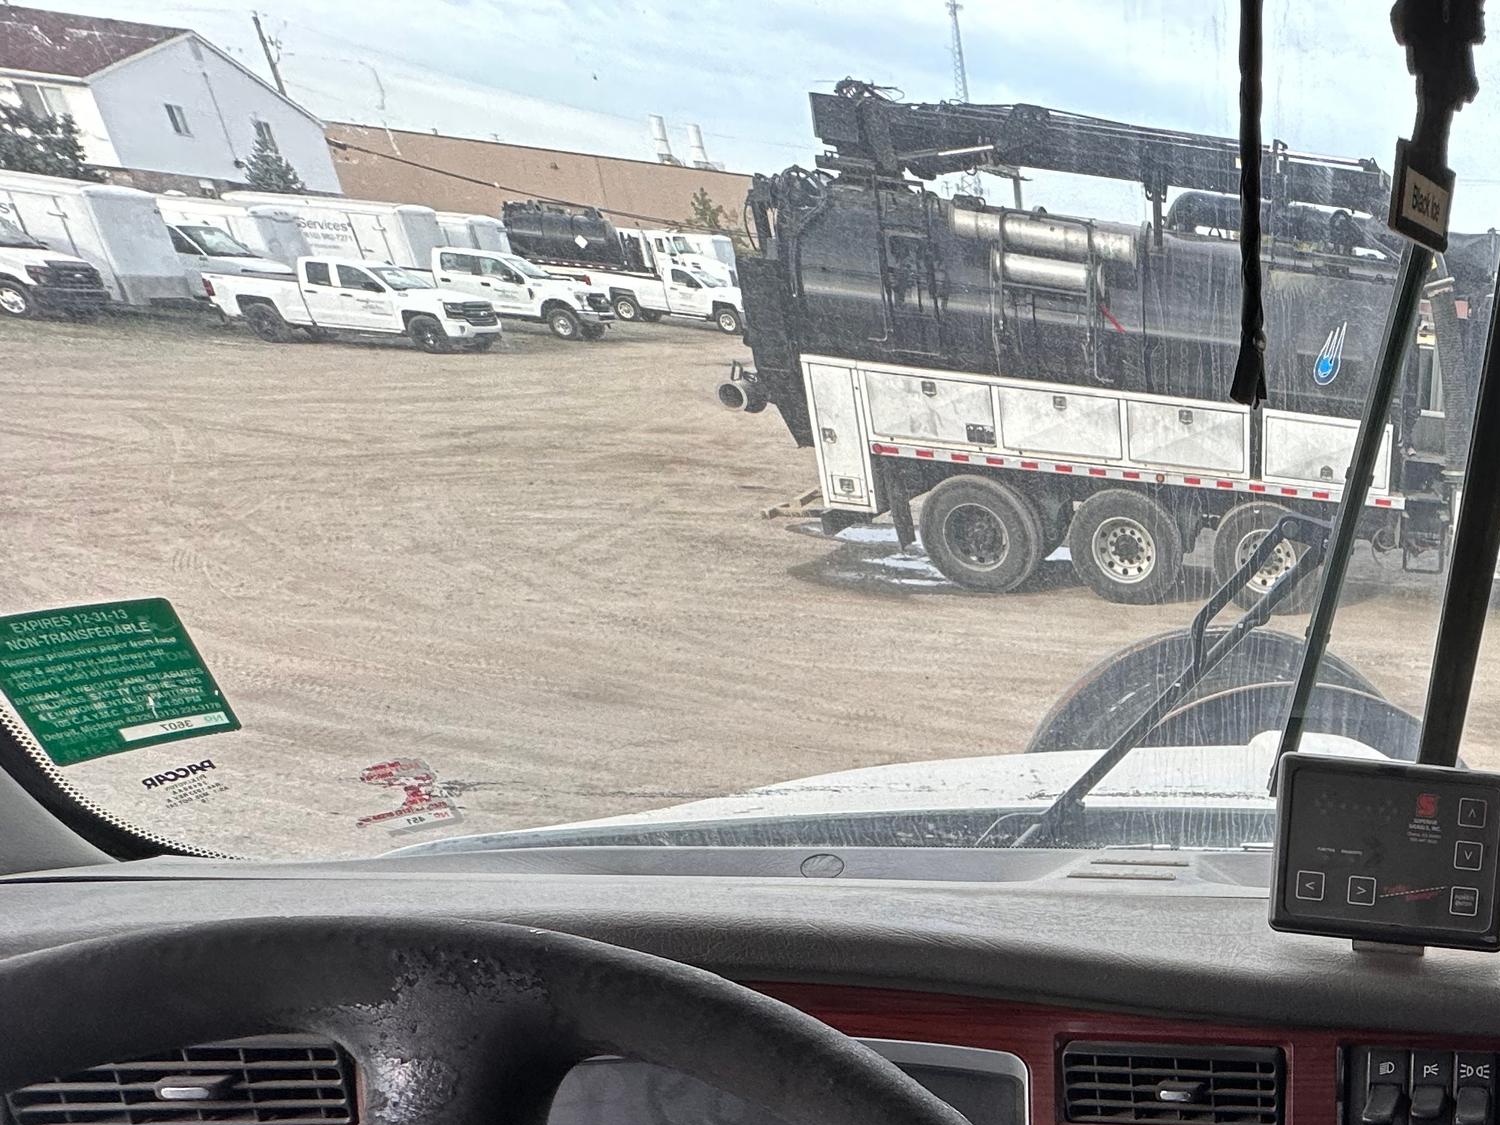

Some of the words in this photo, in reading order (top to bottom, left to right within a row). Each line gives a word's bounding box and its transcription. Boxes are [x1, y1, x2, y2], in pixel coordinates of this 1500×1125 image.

[10, 615, 72, 634] EXPIRES
[74, 609, 128, 624] 12-31-13
[5, 622, 152, 651] NON-TRANSFERABLE
[0, 654, 45, 668] Remove
[47, 646, 100, 661] protective
[101, 641, 128, 653] paper
[129, 638, 153, 648] from
[119, 651, 149, 661] lower
[14, 690, 60, 706] BUREAU
[72, 678, 122, 693] WEIGHTS
[123, 675, 146, 685] AND
[146, 667, 204, 682] MEASURES
[88, 686, 131, 701] SAFETY
